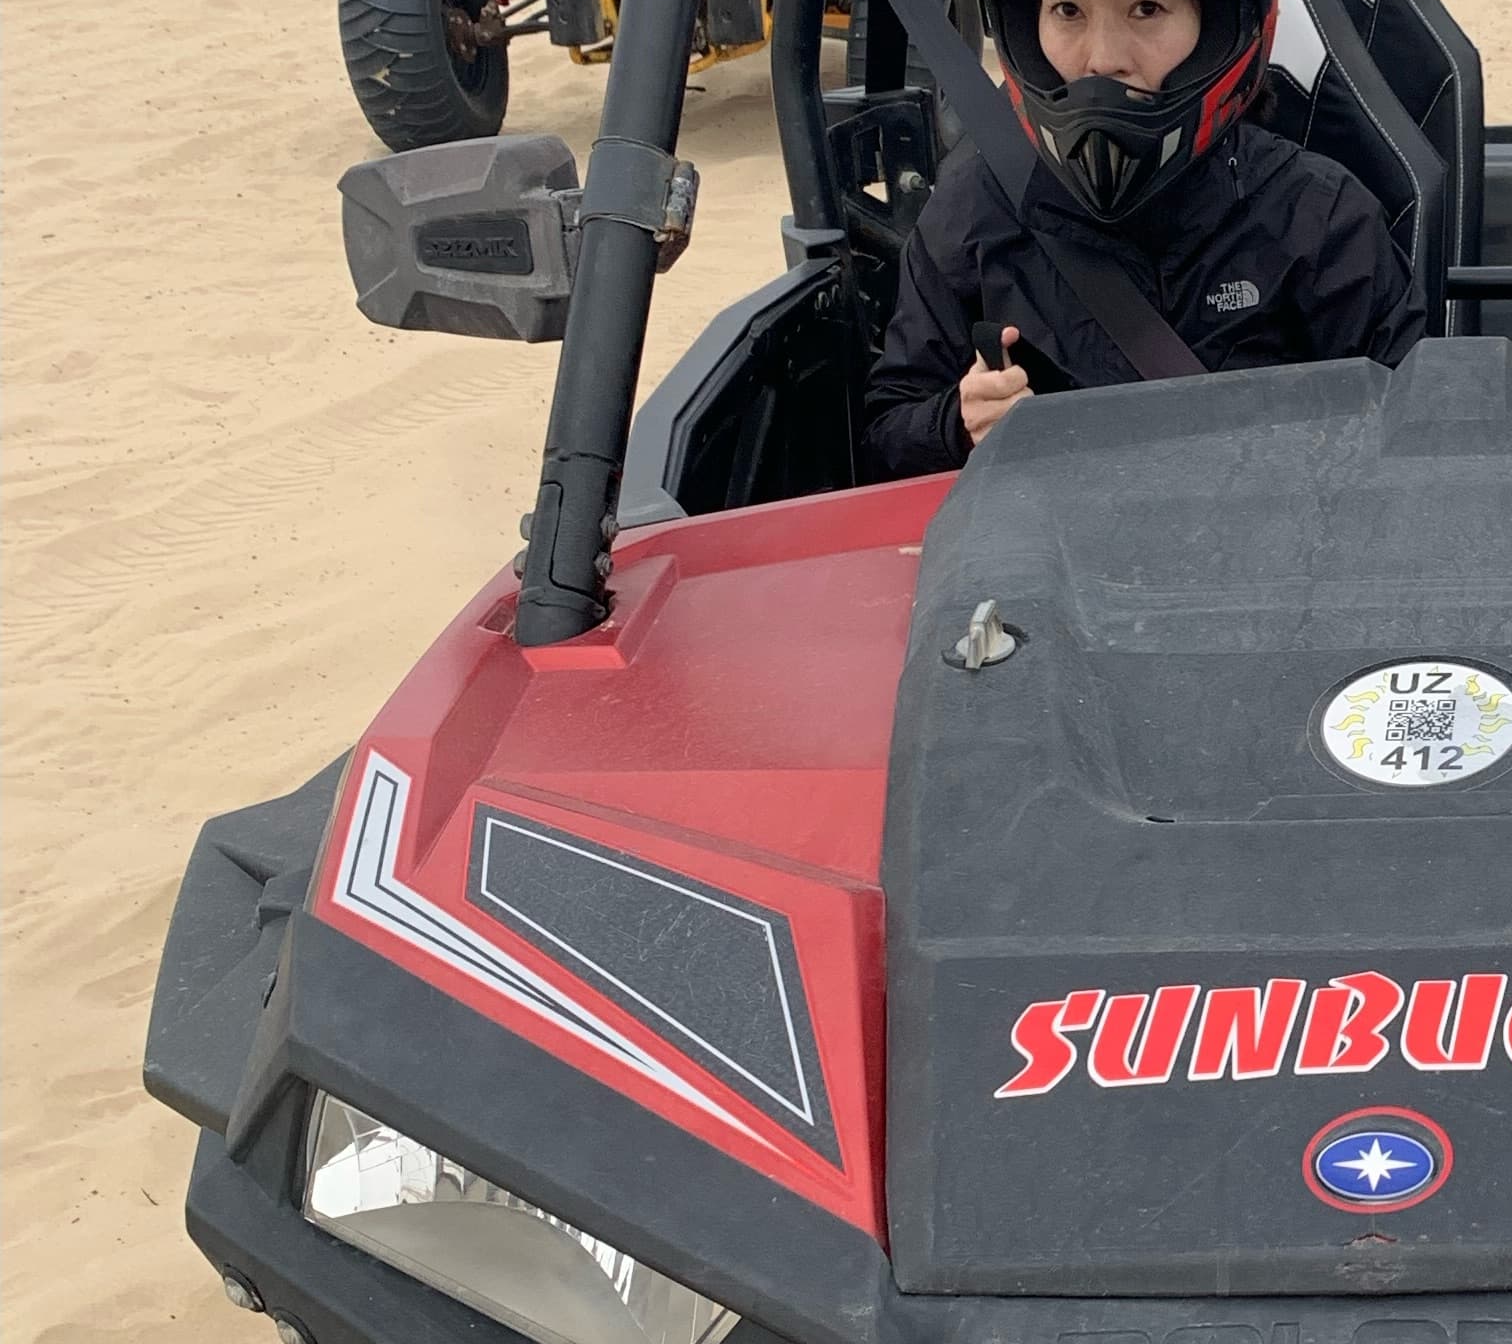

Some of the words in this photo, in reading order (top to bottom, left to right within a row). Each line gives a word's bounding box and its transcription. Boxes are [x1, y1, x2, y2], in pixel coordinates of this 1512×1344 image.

[1220, 282, 1241, 293] THE
[1206, 293, 1242, 305] NORTH
[1217, 301, 1242, 312] FACE
[1390, 673, 1453, 694] UZ
[1380, 745, 1464, 770] 412
